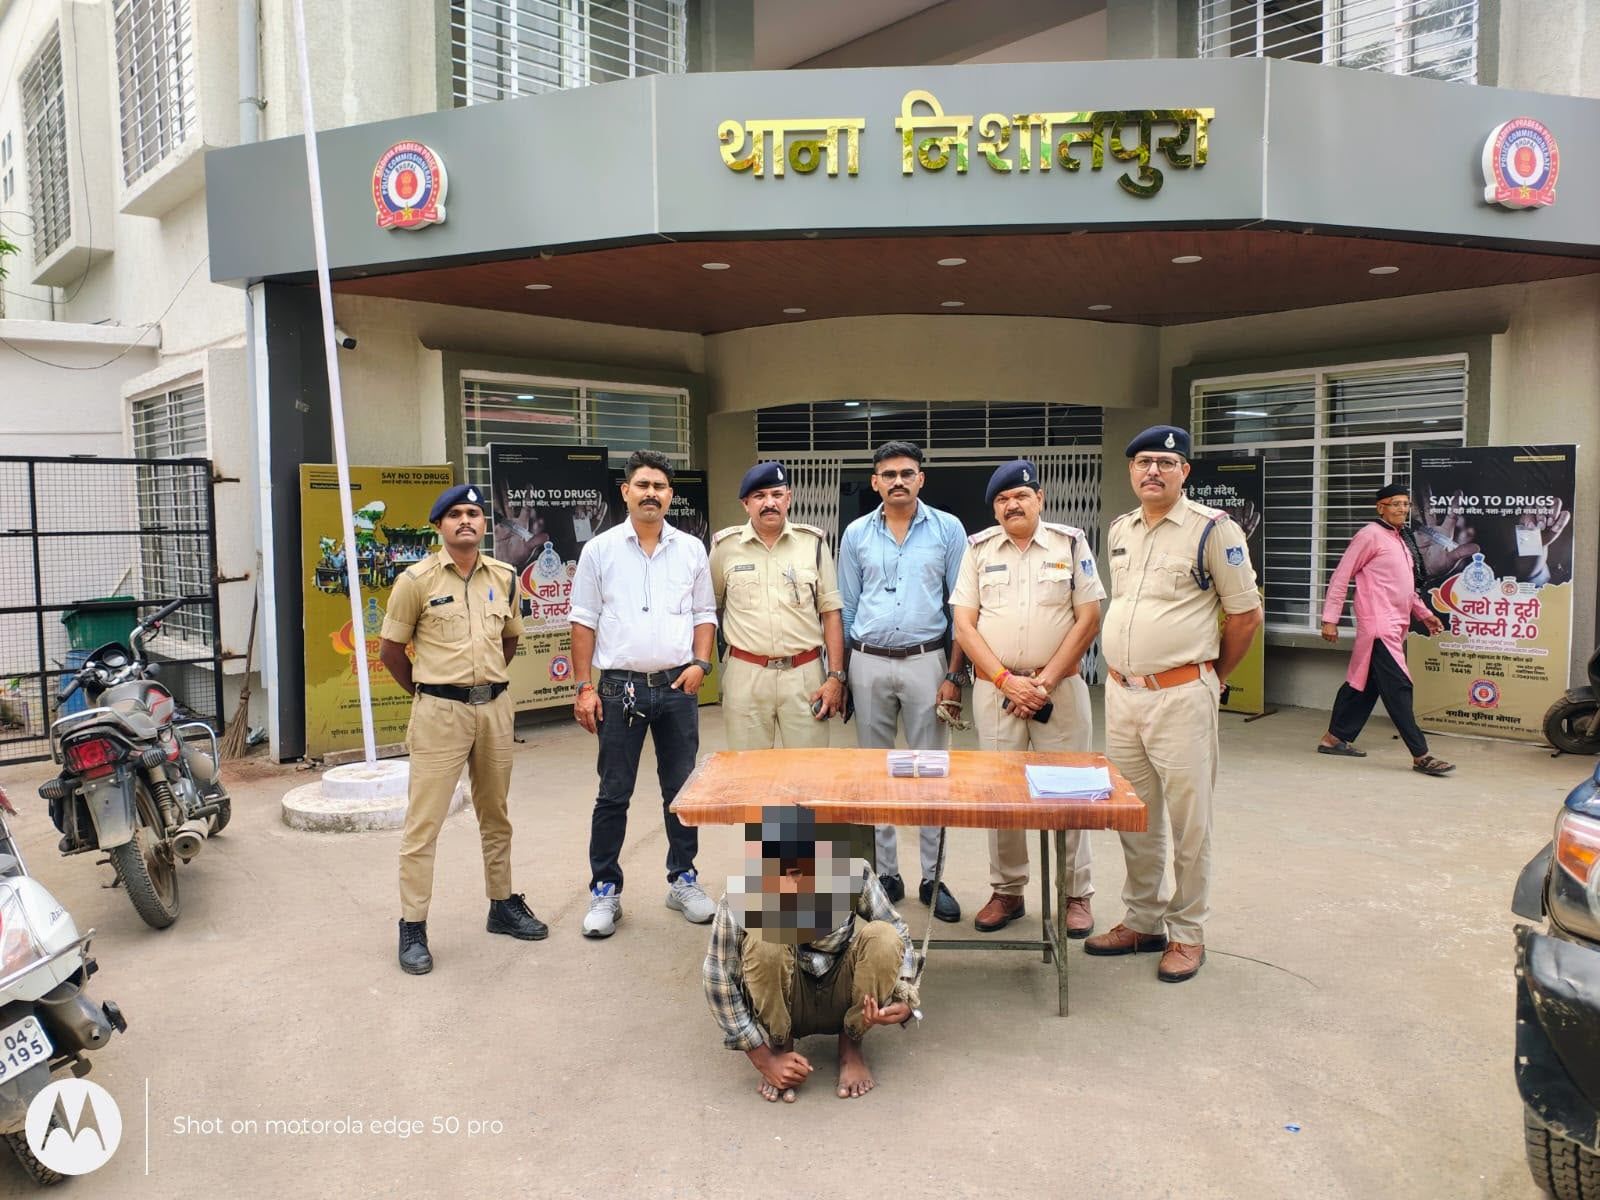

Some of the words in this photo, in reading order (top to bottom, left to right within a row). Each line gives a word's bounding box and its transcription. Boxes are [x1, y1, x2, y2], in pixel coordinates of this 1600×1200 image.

[717, 117, 865, 178] थाना
[895, 89, 1216, 199] निशातपुरा
[507, 489, 528, 499] SAY
[530, 489, 546, 499] NO
[548, 489, 562, 499] TO
[564, 489, 597, 499] DRUGS
[1197, 485, 1211, 496] यही
[1214, 484, 1238, 496] संदेश,
[1225, 496, 1245, 507] प्रदेश
[1429, 495, 1455, 506] SAY
[1458, 495, 1479, 506] NO
[1482, 495, 1501, 506] TO
[1505, 495, 1554, 506] DRUGS
[538, 580, 560, 598] नशे
[562, 579, 572, 596] से
[532, 600, 540, 619] है
[1461, 596, 1491, 615] नशे
[1494, 598, 1510, 616] से
[1513, 598, 1540, 623] दूरी
[1451, 614, 1461, 635] है
[1465, 618, 1507, 637] ज़रूरी
[1511, 624, 1537, 638] 2.0
[4, 1030, 27, 1050] 04
